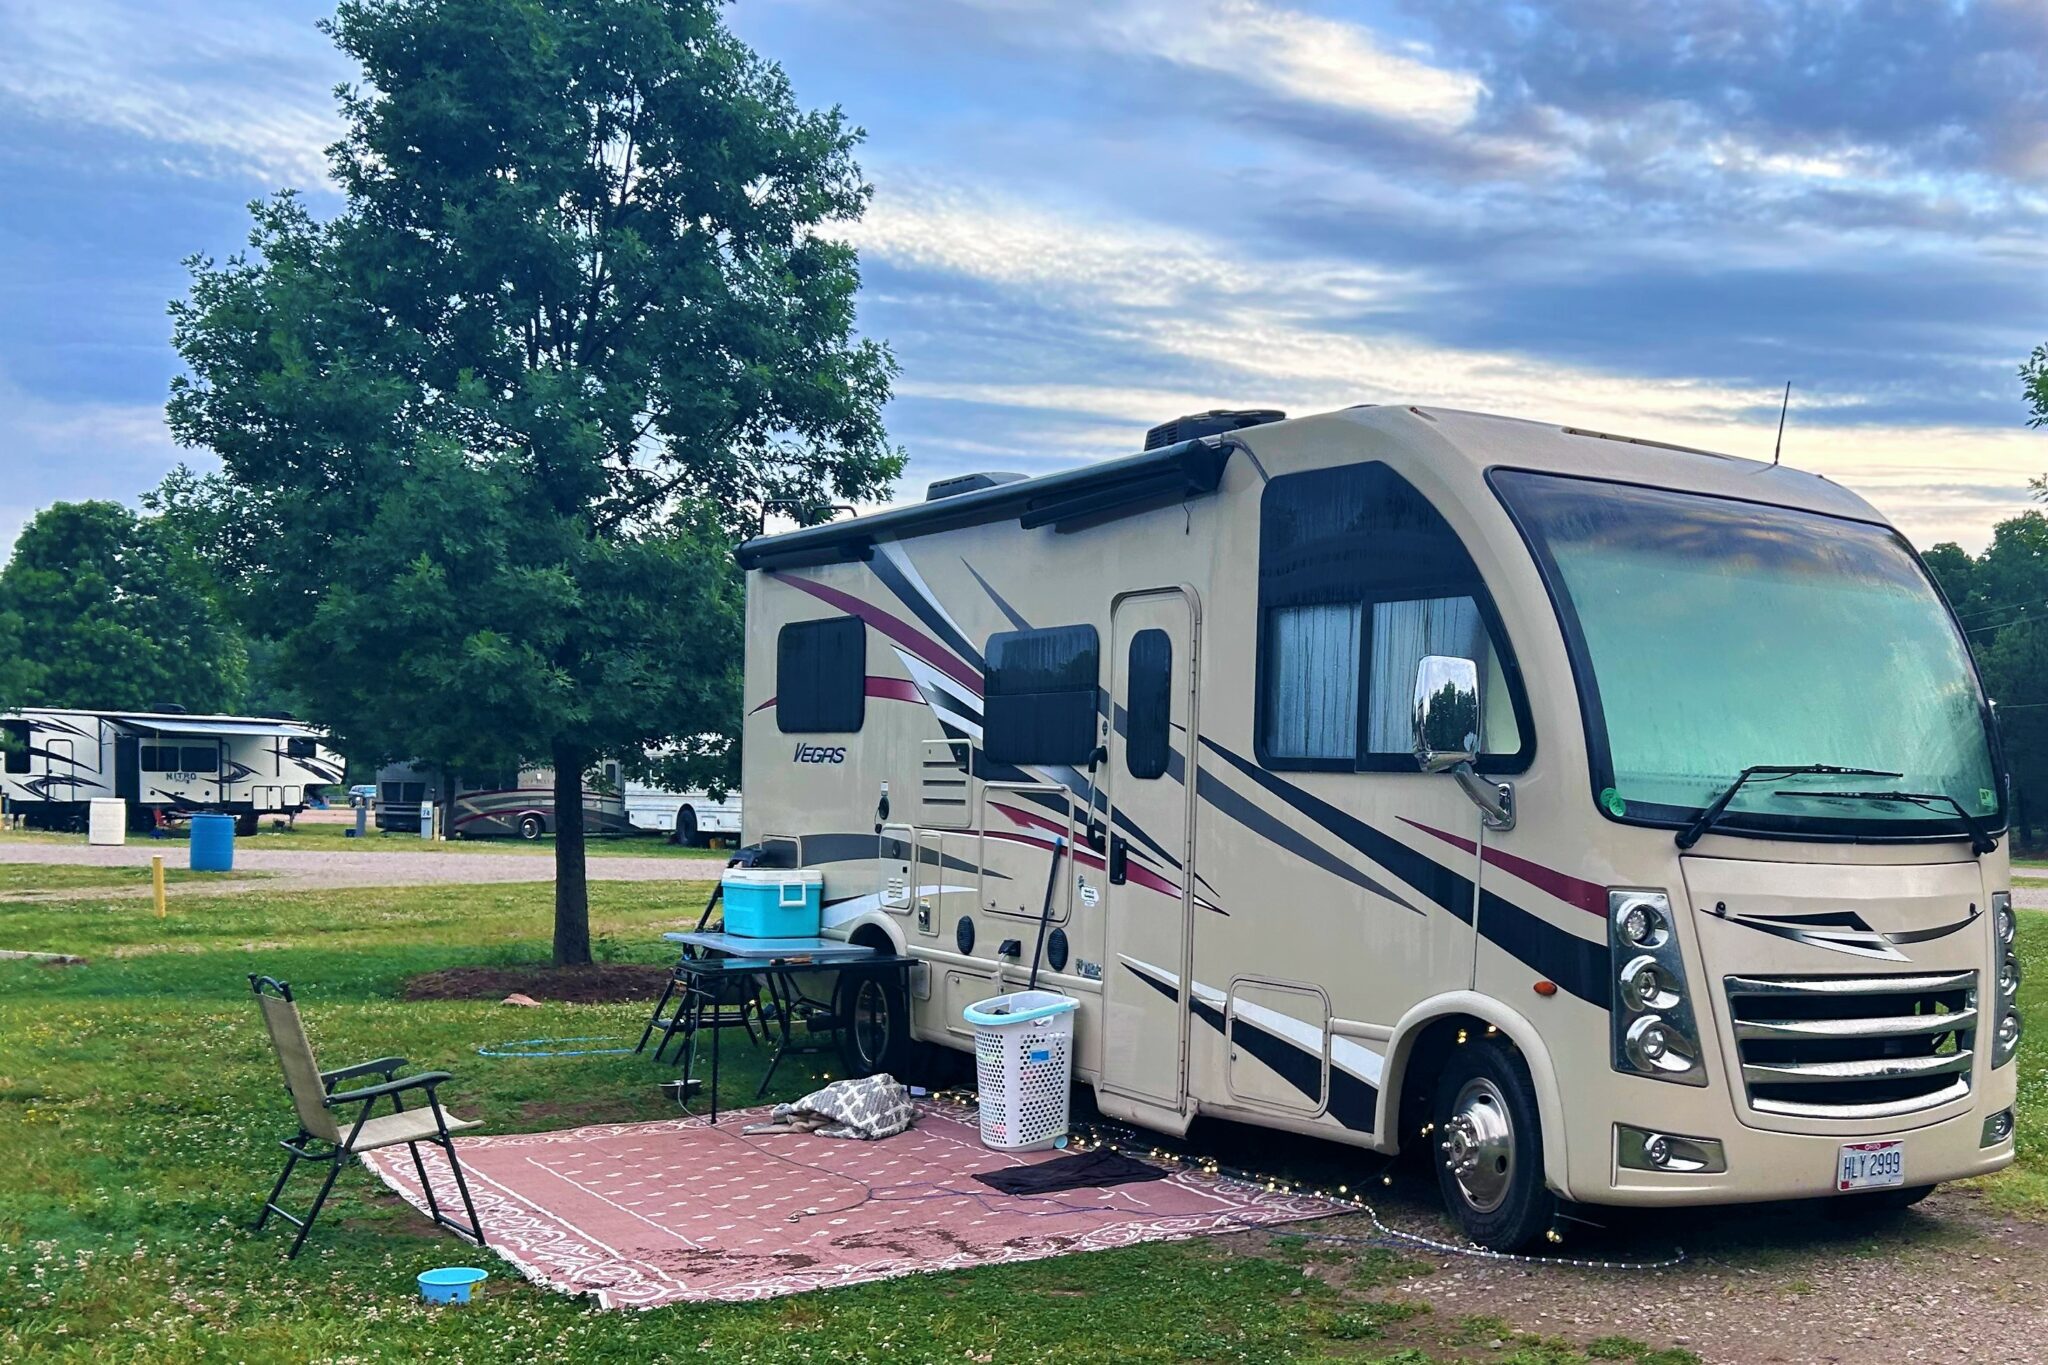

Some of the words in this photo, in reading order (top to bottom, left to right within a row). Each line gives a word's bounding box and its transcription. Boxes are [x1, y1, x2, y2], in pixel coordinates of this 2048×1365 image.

[793, 742, 847, 764] VEGAS
[166, 772, 197, 781] NITRO
[1844, 1155, 1867, 1179] HLY
[1870, 1152, 1900, 1176] 2999
